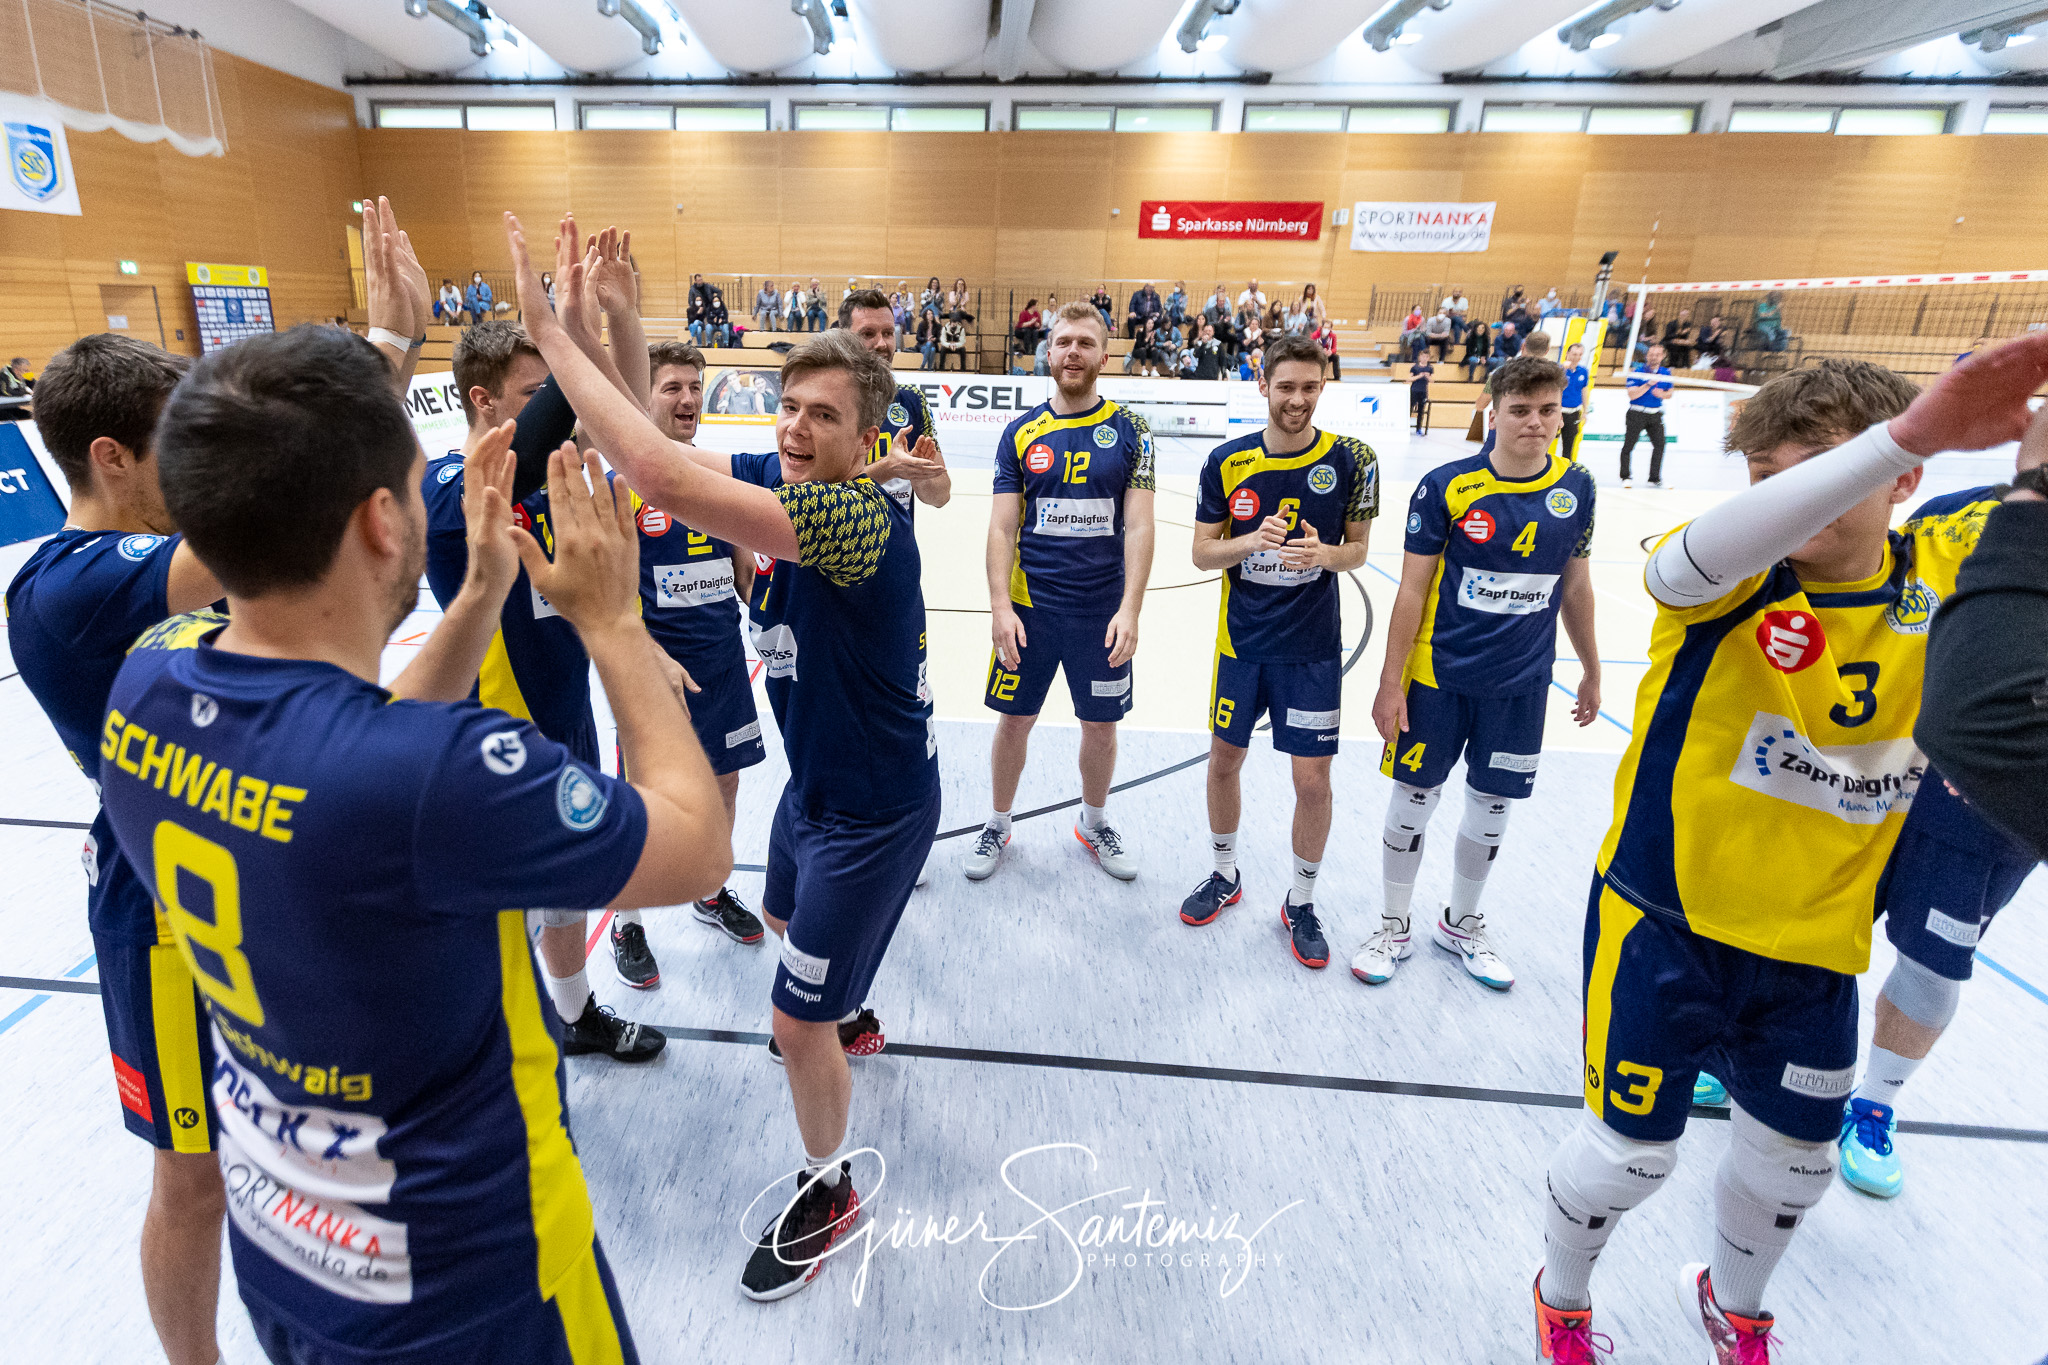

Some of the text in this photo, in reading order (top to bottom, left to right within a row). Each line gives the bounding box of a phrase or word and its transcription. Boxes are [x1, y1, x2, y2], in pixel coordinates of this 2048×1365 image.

[1177, 217, 1243, 234] Sparkasse
[1245, 217, 1309, 236] Nürnberg
[1358, 210, 1487, 226] SPORTNANKA
[915, 384, 1034, 411] EYSEL
[1062, 450, 1092, 484] 12
[1230, 456, 1256, 468] Kempa
[1456, 482, 1485, 495] Kempa
[1046, 513, 1109, 526] Zapf Daigfuss
[1511, 521, 1539, 557] 4
[1252, 562, 1278, 573] Zapf
[672, 575, 734, 594] Zapf Daigfuss
[1477, 587, 1509, 599] Zapf
[990, 668, 1020, 701] 12
[1828, 661, 1881, 728] 3
[1215, 696, 1236, 729] 6
[1317, 734, 1339, 742] Kemp
[1400, 742, 1427, 773] 4
[1779, 751, 1840, 788] Zapf
[100, 708, 308, 844] SCHWABE
[153, 819, 265, 1028] 8
[785, 978, 822, 1004] Kempa
[1610, 1060, 1664, 1115] 3
[224, 1163, 382, 1258] ORTNANKA
